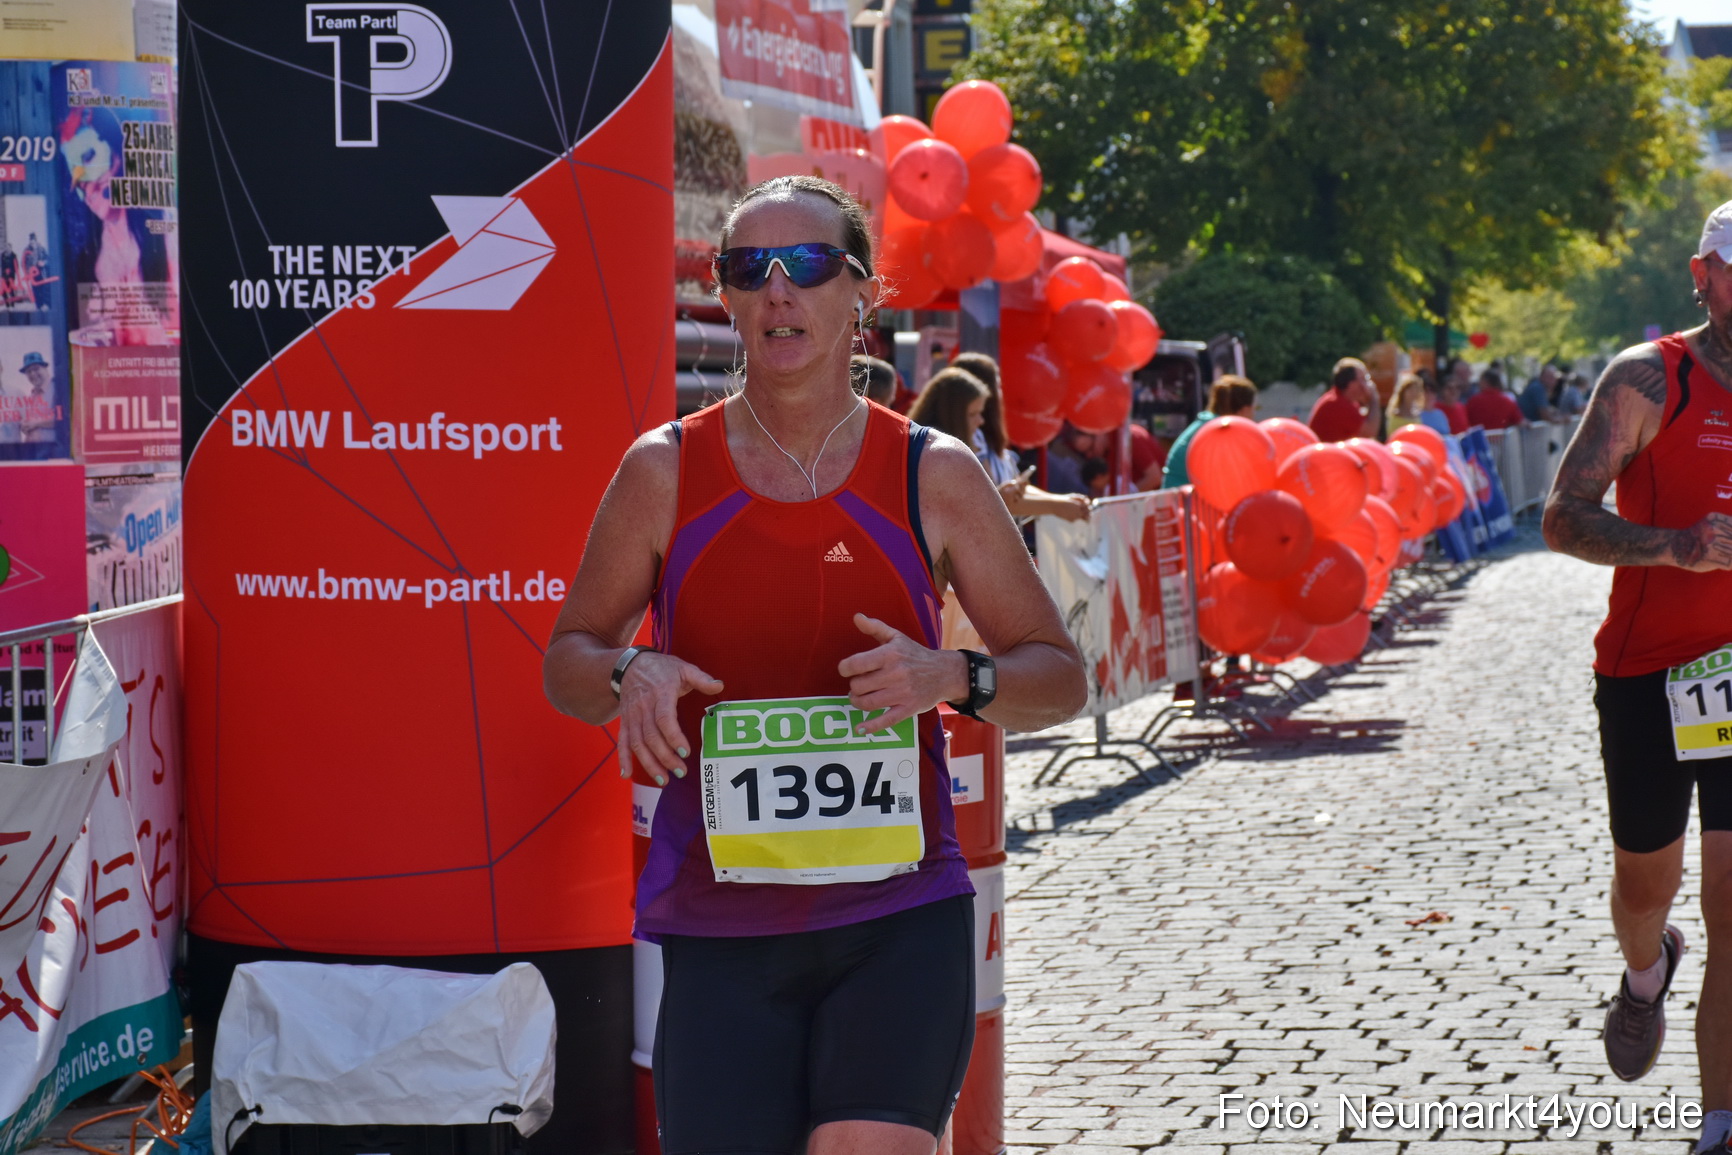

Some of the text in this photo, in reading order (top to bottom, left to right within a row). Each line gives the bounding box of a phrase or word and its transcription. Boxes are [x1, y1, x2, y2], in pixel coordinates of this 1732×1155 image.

[315, 15, 397, 29] Team Partl
[84, 96, 100, 106] und
[1, 136, 56, 161] 2019
[268, 245, 416, 276] THE NEXT
[229, 279, 376, 309] 100 YEARS
[232, 410, 563, 459] BMW Laufsport
[125, 509, 163, 558] Open
[824, 554, 854, 562] adidas
[235, 569, 566, 608] www.bmw-partl.de
[718, 704, 901, 750] BOCK
[730, 761, 896, 822] 1394
